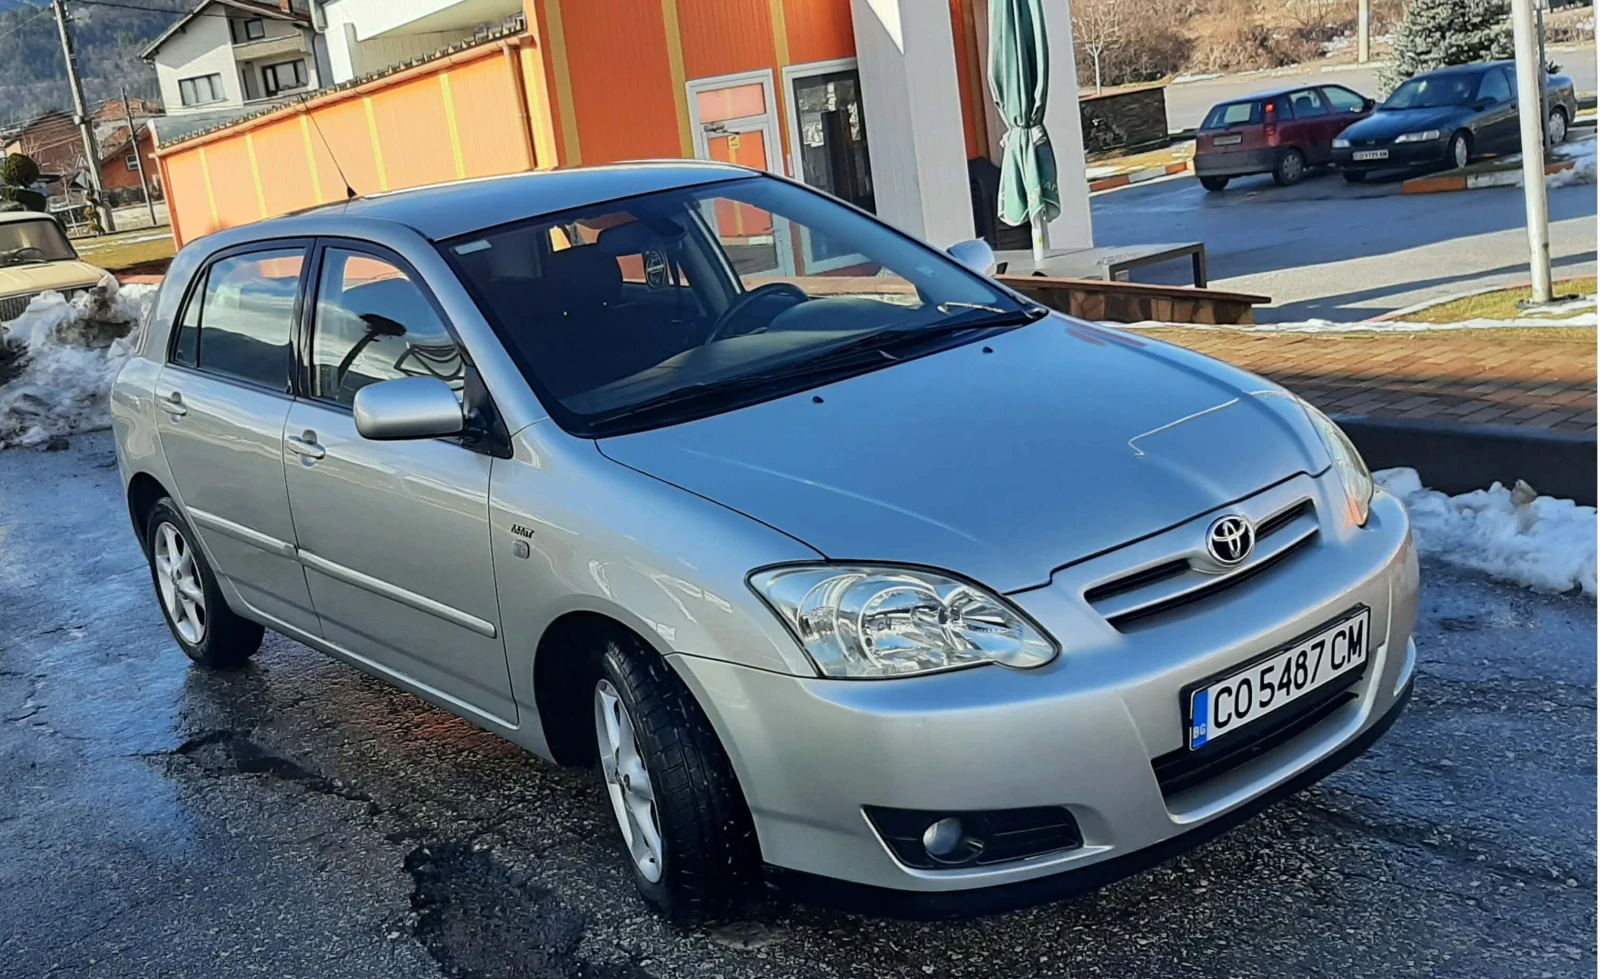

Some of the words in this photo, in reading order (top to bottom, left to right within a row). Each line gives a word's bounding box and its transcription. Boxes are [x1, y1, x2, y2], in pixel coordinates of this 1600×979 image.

[1213, 677, 1253, 729] CO
[1259, 638, 1325, 708] 5487
[1330, 619, 1364, 671] CM
[1192, 723, 1206, 739] BG
